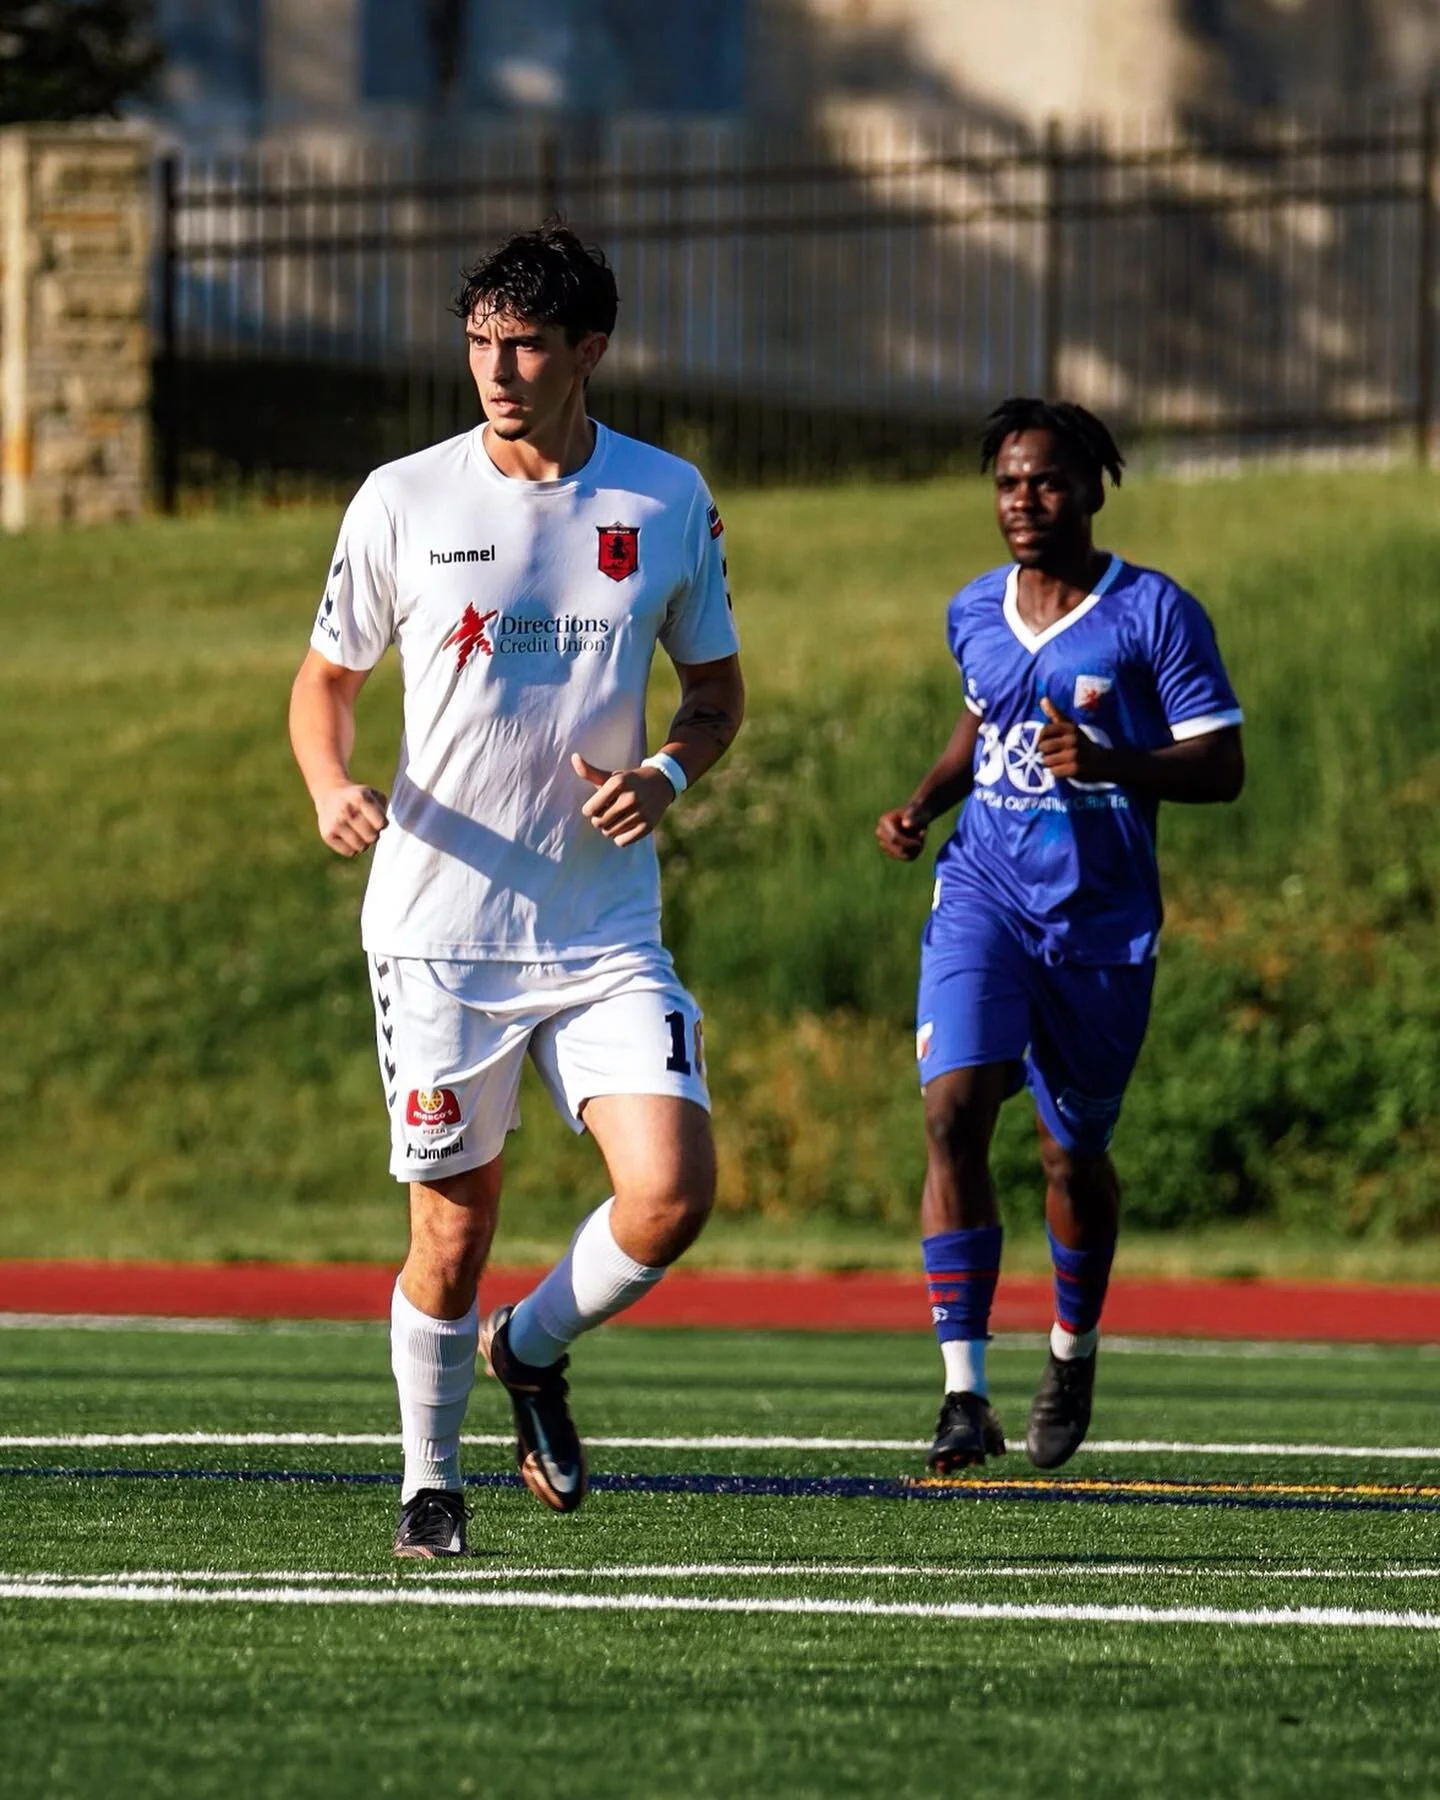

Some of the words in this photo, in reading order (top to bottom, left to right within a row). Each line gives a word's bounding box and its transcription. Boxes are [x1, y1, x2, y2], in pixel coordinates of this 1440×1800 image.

[430, 544, 495, 566] hummel
[500, 614, 610, 635] Directions
[499, 637, 548, 654] Credit
[553, 636, 606, 653] Union
[406, 1136, 464, 1160] hummel
